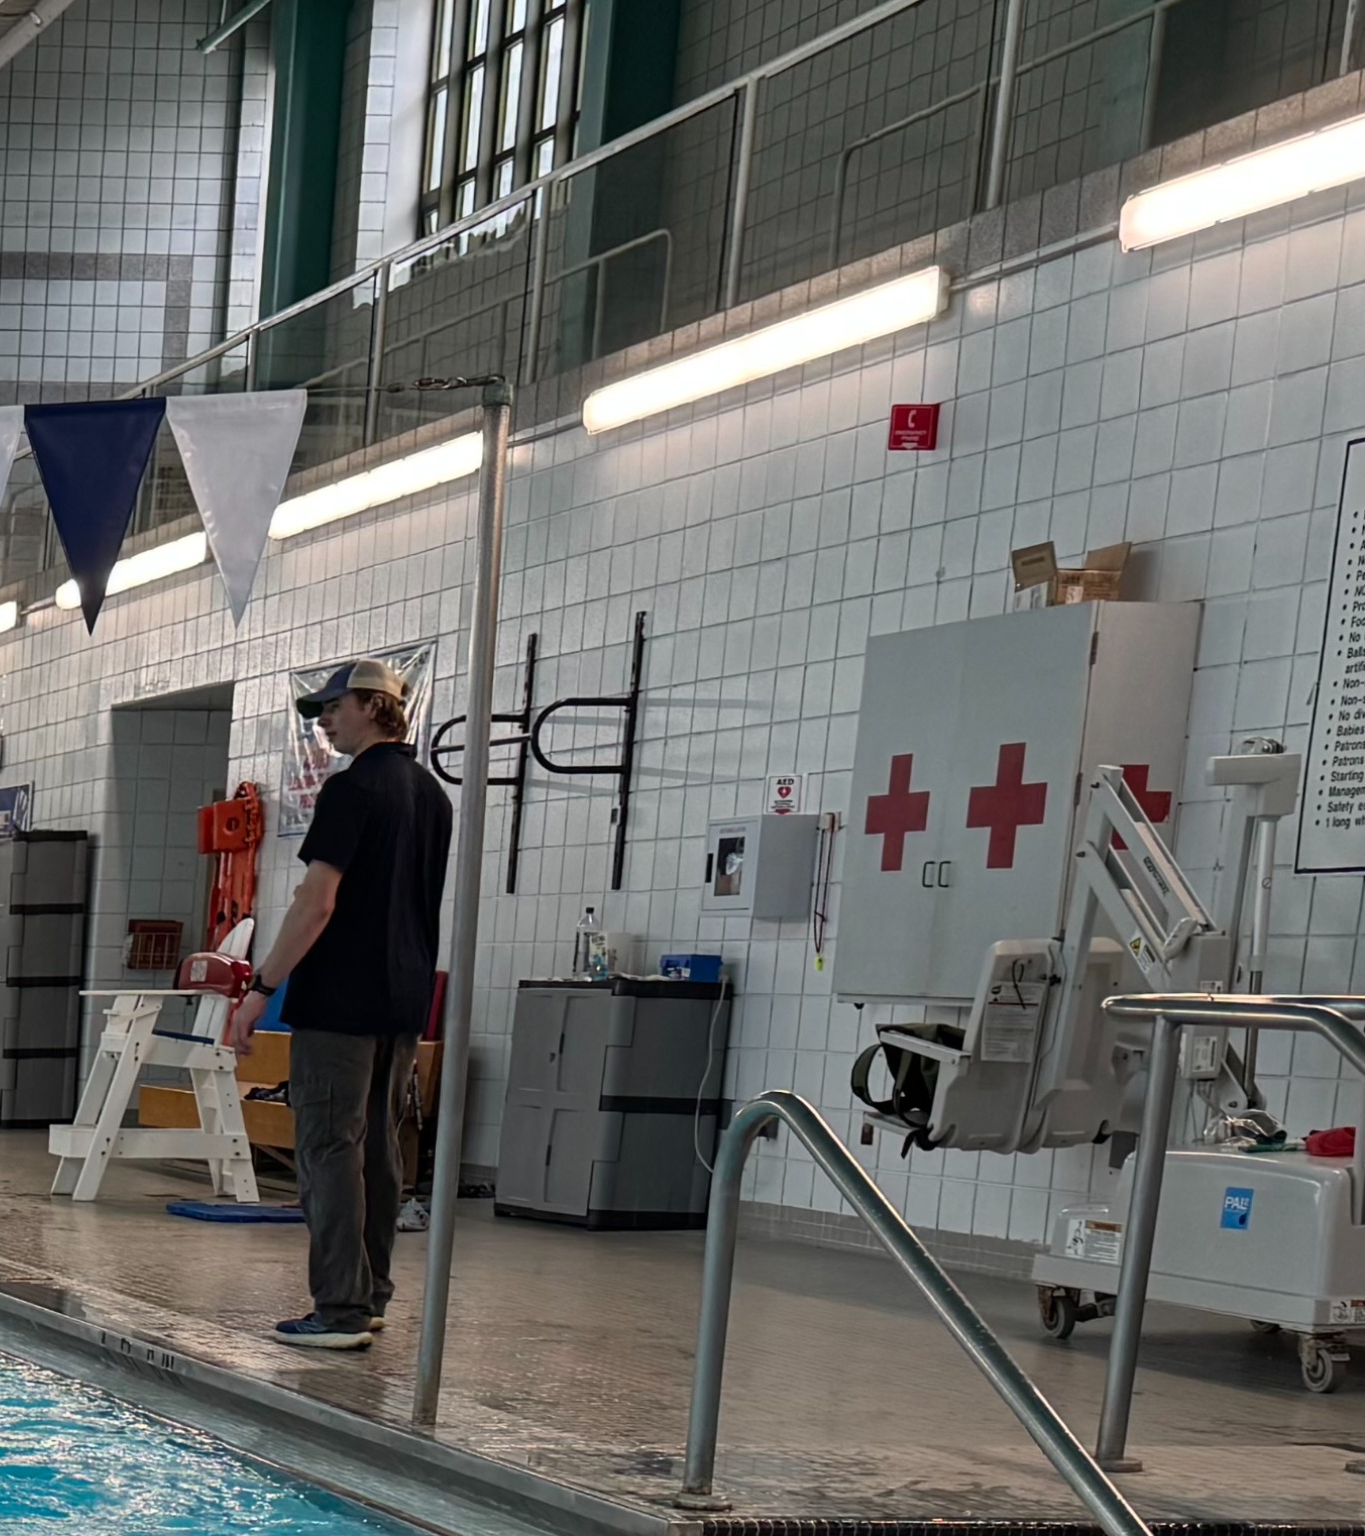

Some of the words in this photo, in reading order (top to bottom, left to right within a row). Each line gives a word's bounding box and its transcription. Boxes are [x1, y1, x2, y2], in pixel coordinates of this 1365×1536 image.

[1349, 632, 1361, 643] No
[1338, 710, 1350, 722] No
[1332, 755, 1364, 767] Patrons
[1330, 770, 1364, 785] Starting
[1327, 801, 1354, 814] Safety
[1331, 815, 1351, 830] long
